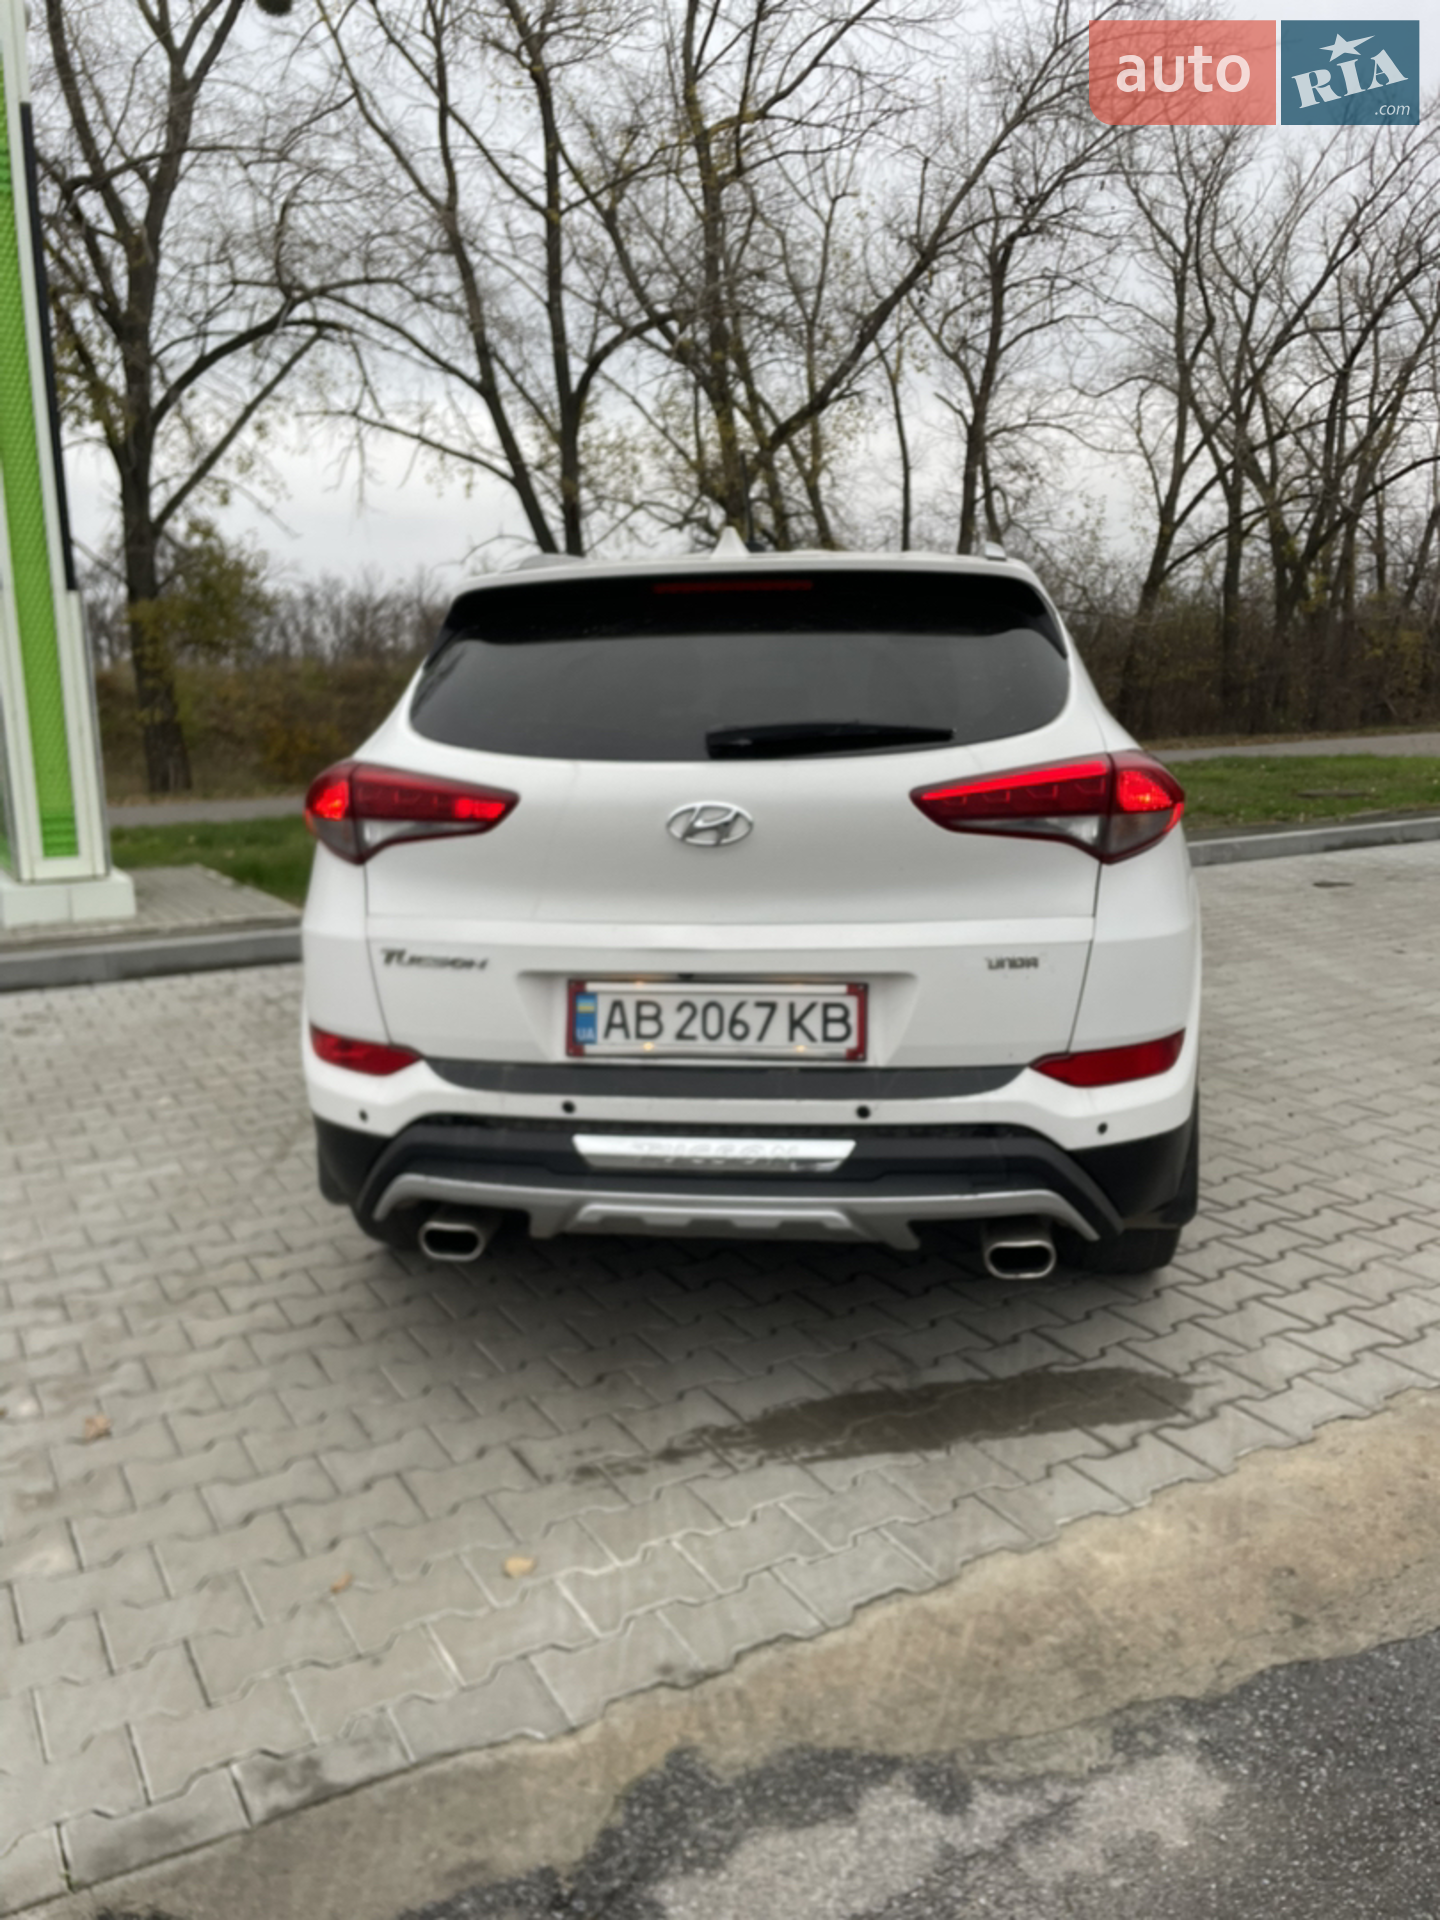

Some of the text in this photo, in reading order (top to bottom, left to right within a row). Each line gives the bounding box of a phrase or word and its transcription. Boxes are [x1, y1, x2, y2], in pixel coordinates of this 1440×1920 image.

[603, 999, 853, 1043] AB 2067 KB
